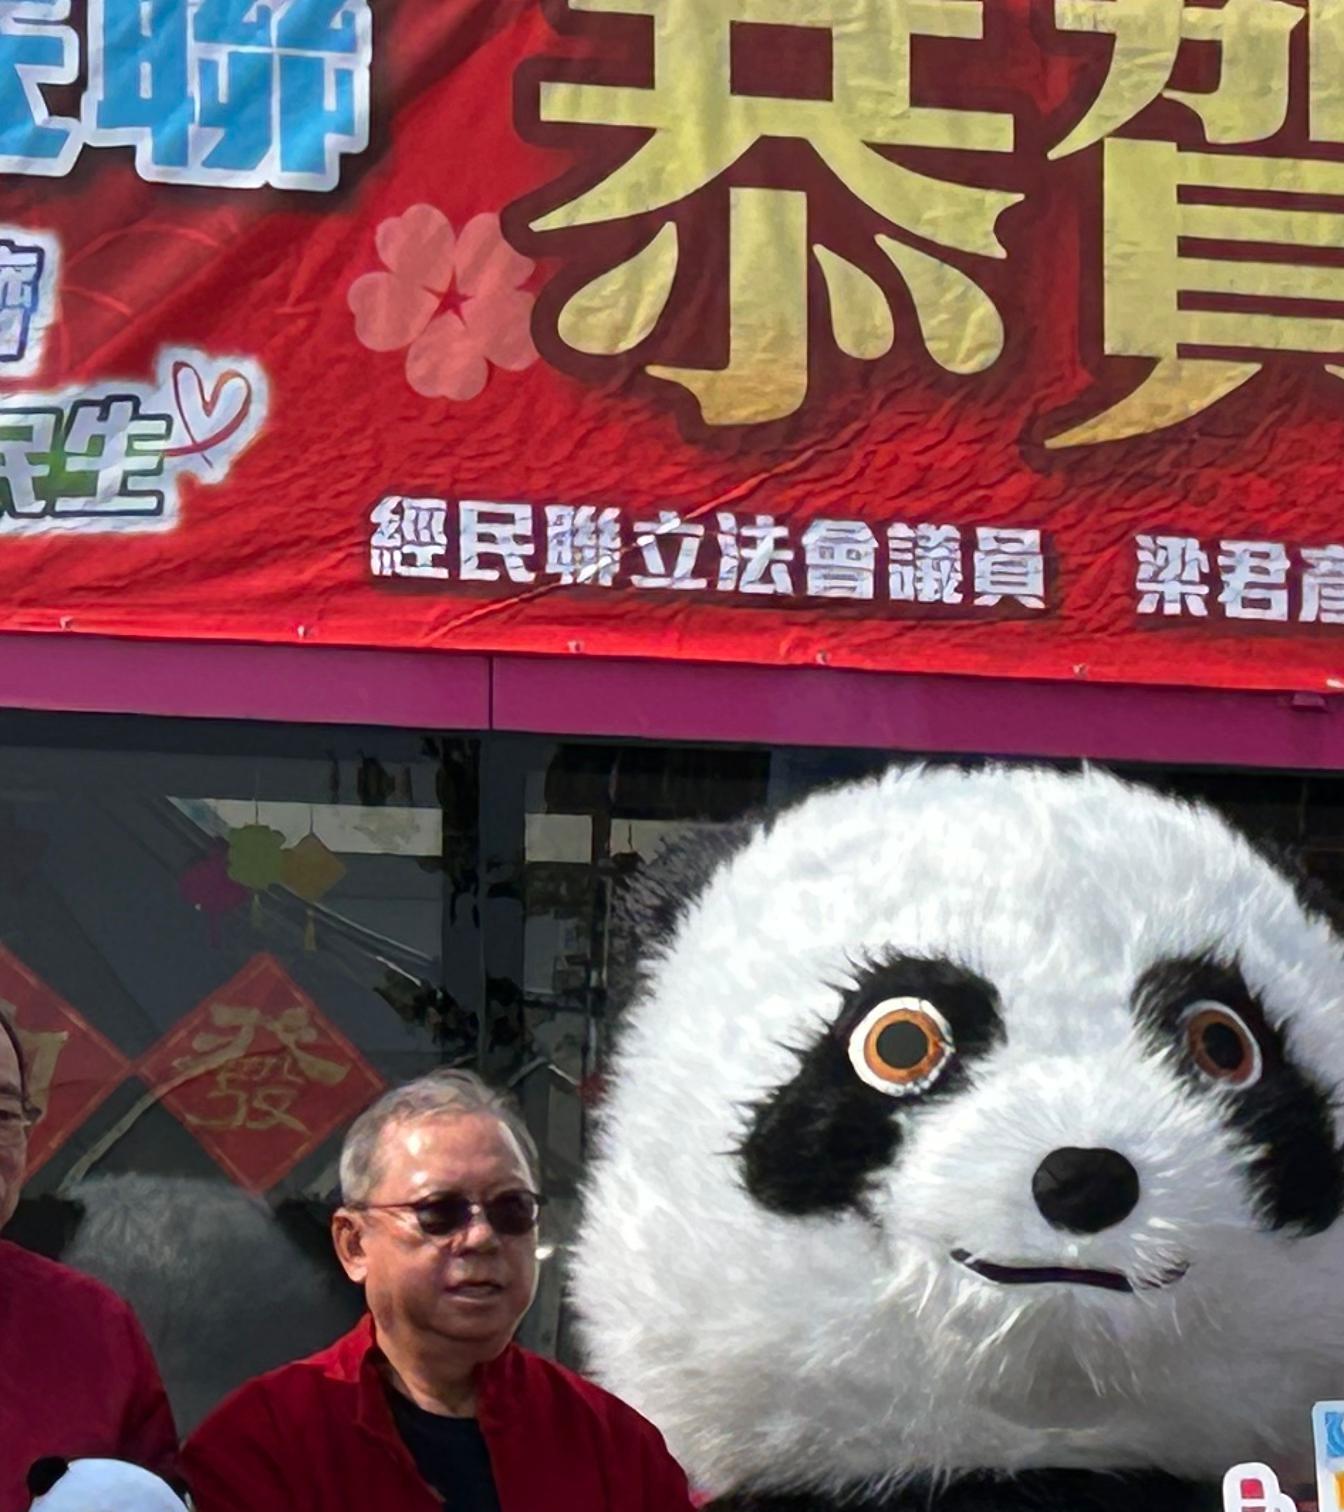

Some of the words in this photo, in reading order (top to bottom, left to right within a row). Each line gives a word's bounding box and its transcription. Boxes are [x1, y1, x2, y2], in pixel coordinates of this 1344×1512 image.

[369, 494, 1047, 610] 經民聯立法會議員
